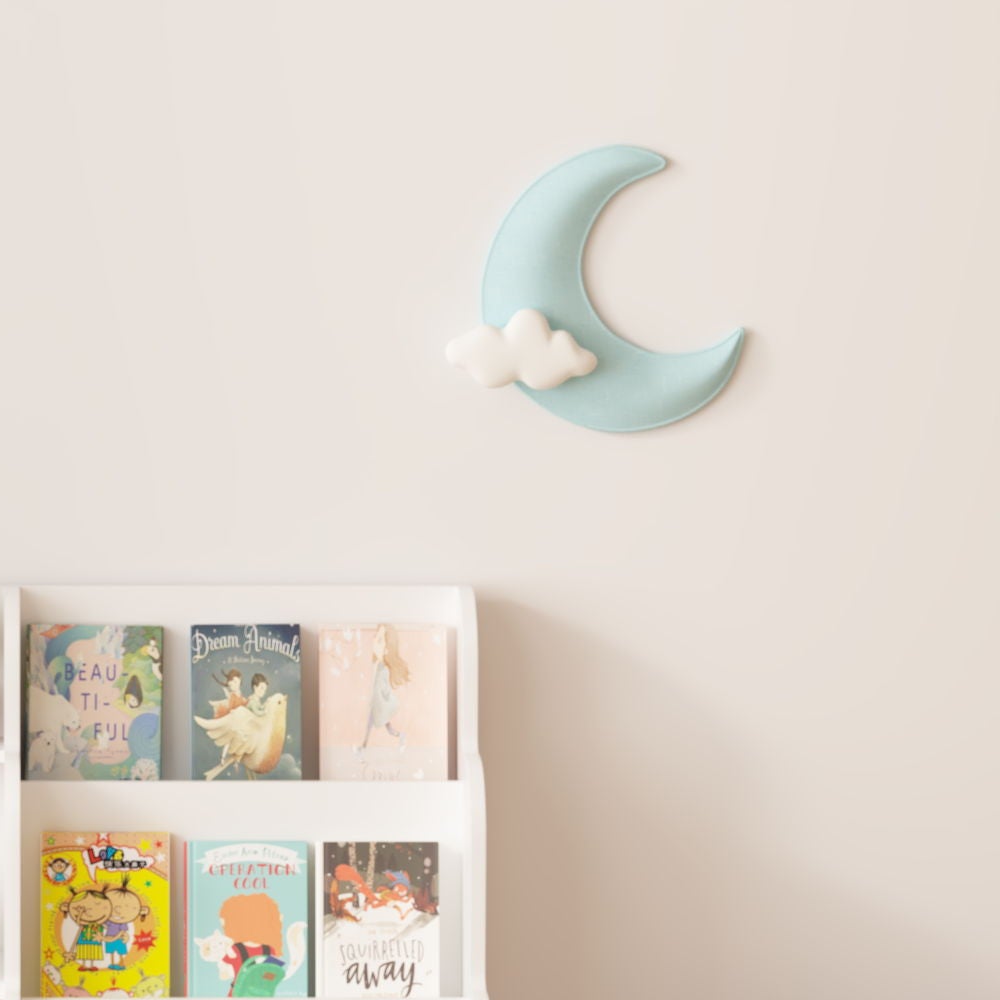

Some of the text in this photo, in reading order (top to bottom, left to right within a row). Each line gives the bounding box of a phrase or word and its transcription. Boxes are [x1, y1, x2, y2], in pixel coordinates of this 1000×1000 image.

[192, 624, 300, 664] Dream Animals
[81, 692, 110, 711] TI-
[94, 722, 128, 741] FUL
[208, 863, 296, 876] OPERATION
[233, 877, 269, 889] COOL
[343, 961, 423, 998] away
